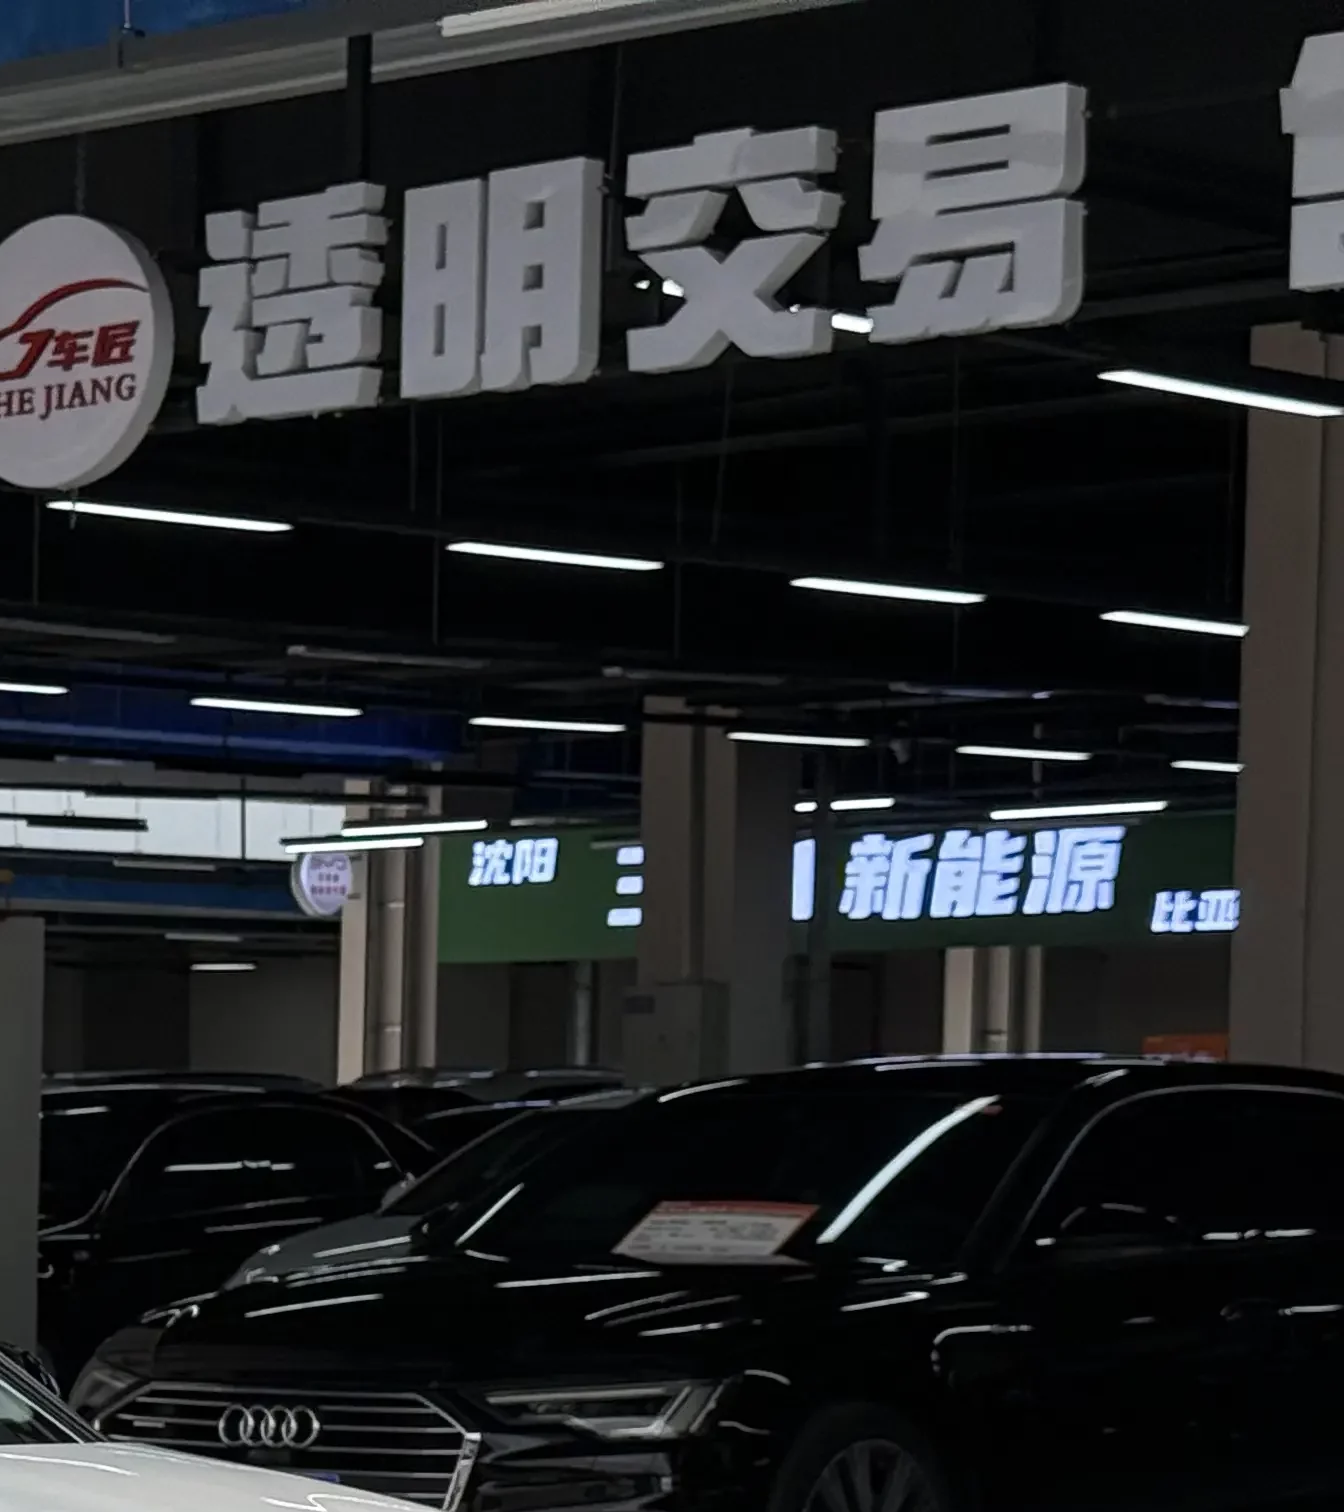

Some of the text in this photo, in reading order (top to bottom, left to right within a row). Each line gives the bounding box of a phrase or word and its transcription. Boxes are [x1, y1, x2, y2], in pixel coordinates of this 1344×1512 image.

[196, 81, 1087, 425] 透明交易
[47, 320, 140, 371] 车匠
[39, 373, 136, 420] JIANG
[468, 837, 559, 886] 沈阳
[838, 826, 1127, 919] 新能源
[1150, 888, 1241, 933] 比亚
